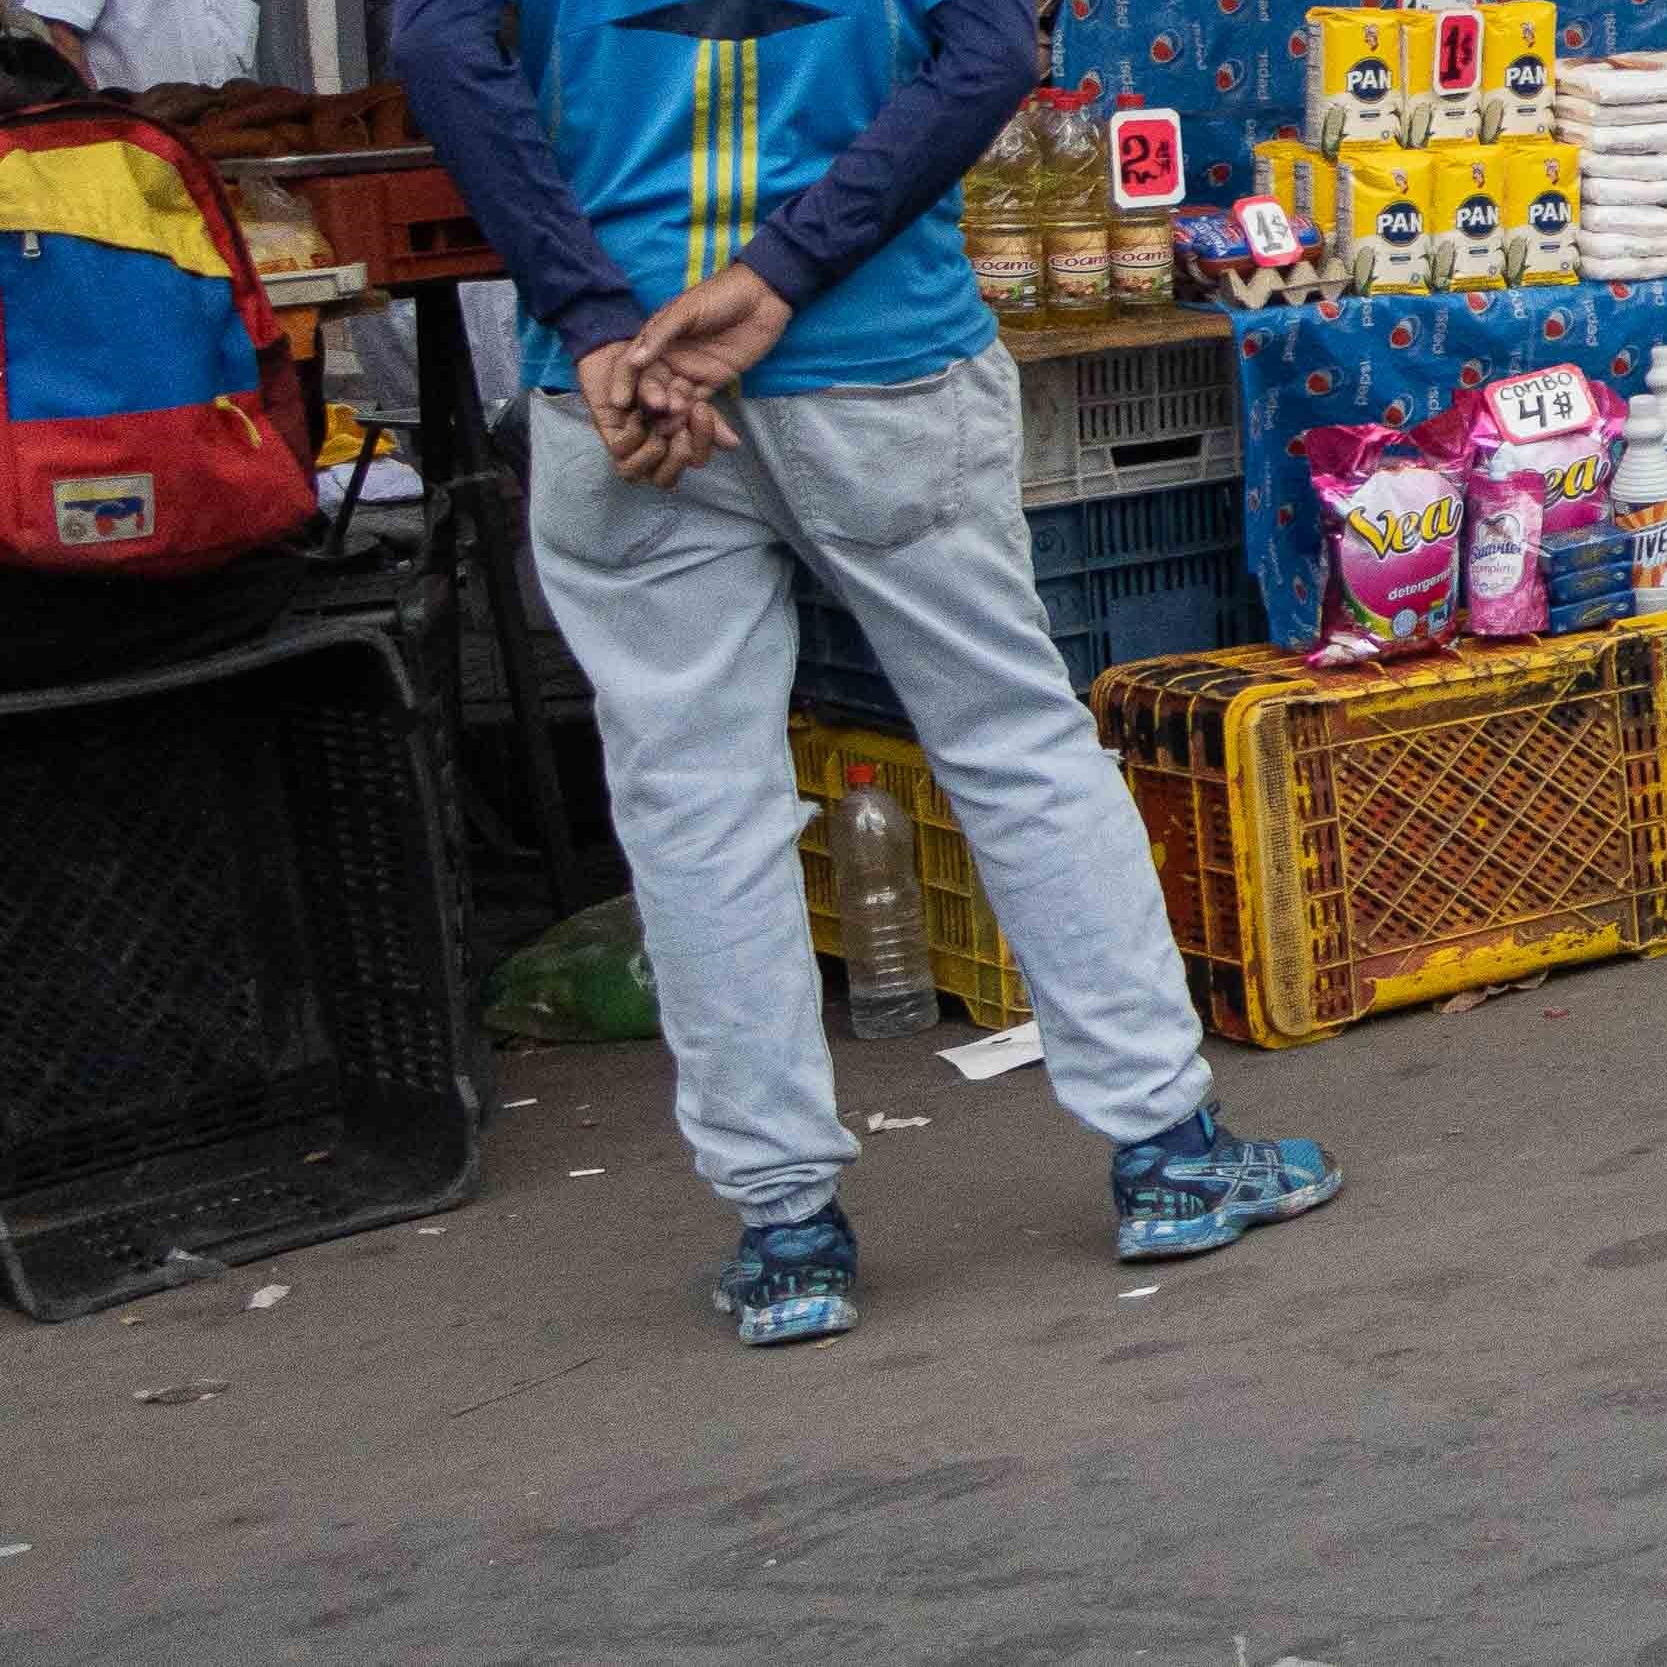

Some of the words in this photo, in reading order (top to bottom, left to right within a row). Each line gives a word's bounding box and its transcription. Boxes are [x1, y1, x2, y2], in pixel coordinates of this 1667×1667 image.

[1346, 70, 1393, 90] PAN
[1505, 65, 1548, 87] PAN
[1376, 210, 1424, 234] PAN
[1455, 205, 1499, 228] PAN
[1528, 201, 1572, 224] PAN
[1346, 494, 1465, 562] Vea
